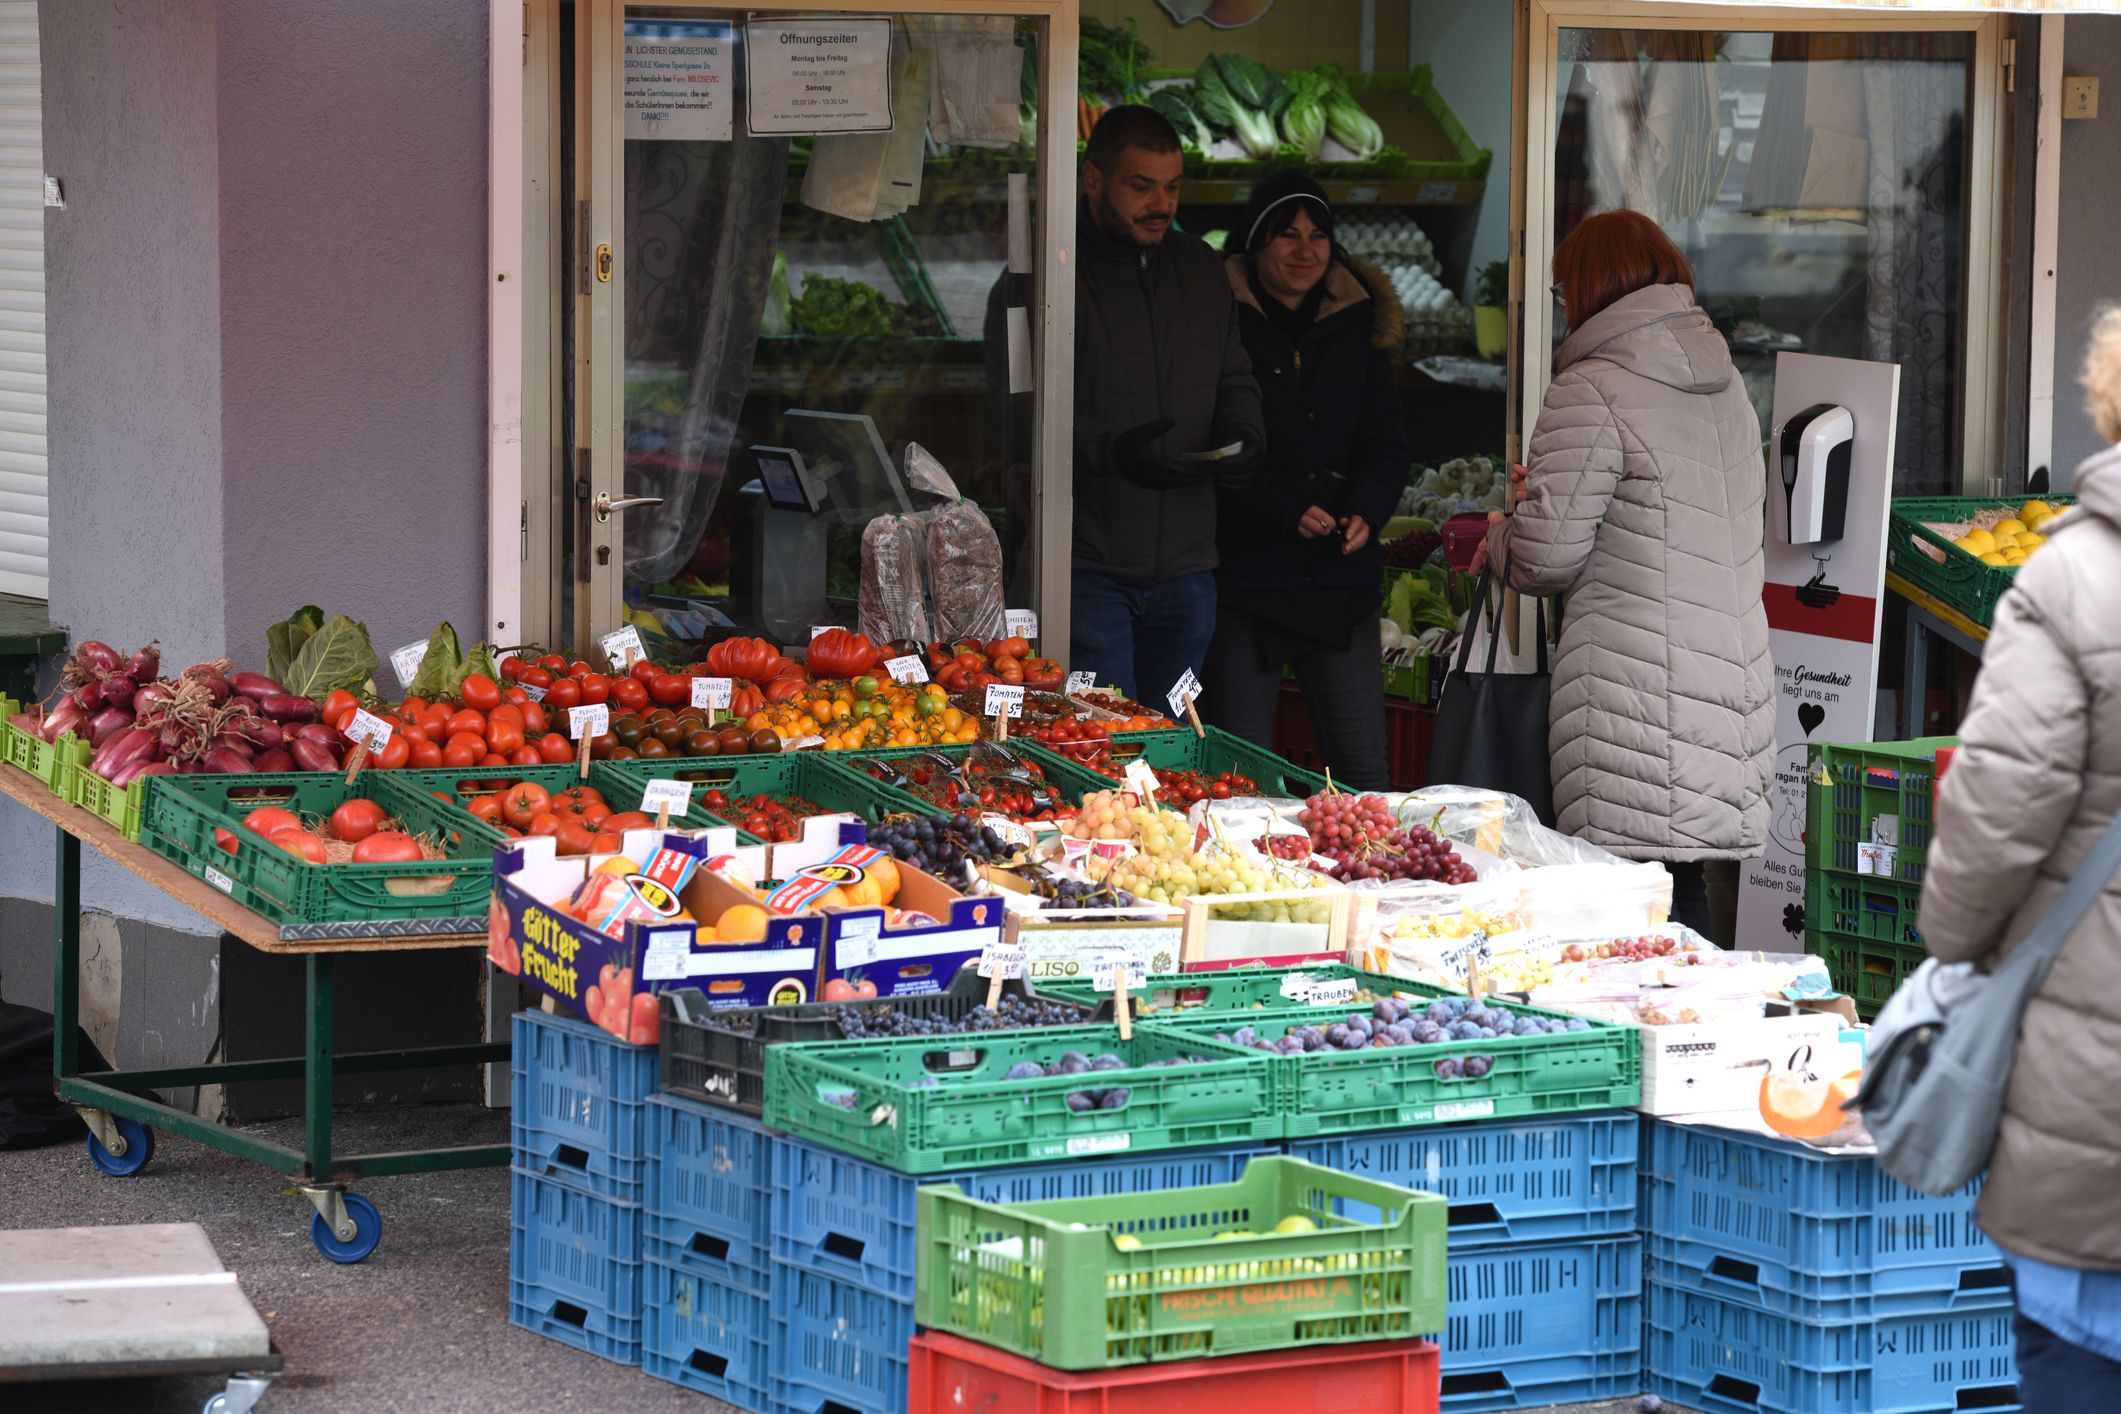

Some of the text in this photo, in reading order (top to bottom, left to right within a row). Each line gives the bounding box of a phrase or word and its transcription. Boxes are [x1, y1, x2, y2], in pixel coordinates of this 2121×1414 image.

[780, 33, 858, 46] Öffnungszeiten
[668, 46, 718, 56] GEMÜSESTAND
[791, 55, 815, 63] Montag
[826, 54, 848, 63] Freitag
[640, 74, 663, 82] herzlich
[663, 74, 672, 82] bei
[837, 69, 847, 77] Uhr
[690, 89, 700, 98] die
[805, 84, 832, 92] Samstag
[635, 100, 675, 109] SchülerInnen
[641, 111, 670, 121] DANKE!!!
[1774, 664, 1853, 688] Ihre Gesundheit
[698, 683, 730, 691] TOMATEN
[990, 690, 1023, 699] TOMATEN
[1783, 683, 1840, 703] liegt uns am
[1775, 772, 1800, 784] ragan
[1763, 859, 1806, 878] Alles Gut
[1750, 873, 1801, 894] bleiben Sie
[521, 905, 581, 964] Götter
[521, 941, 578, 1000] Frucht
[1031, 961, 1079, 977] LISO
[1311, 988, 1355, 1001] TRAUBEN
